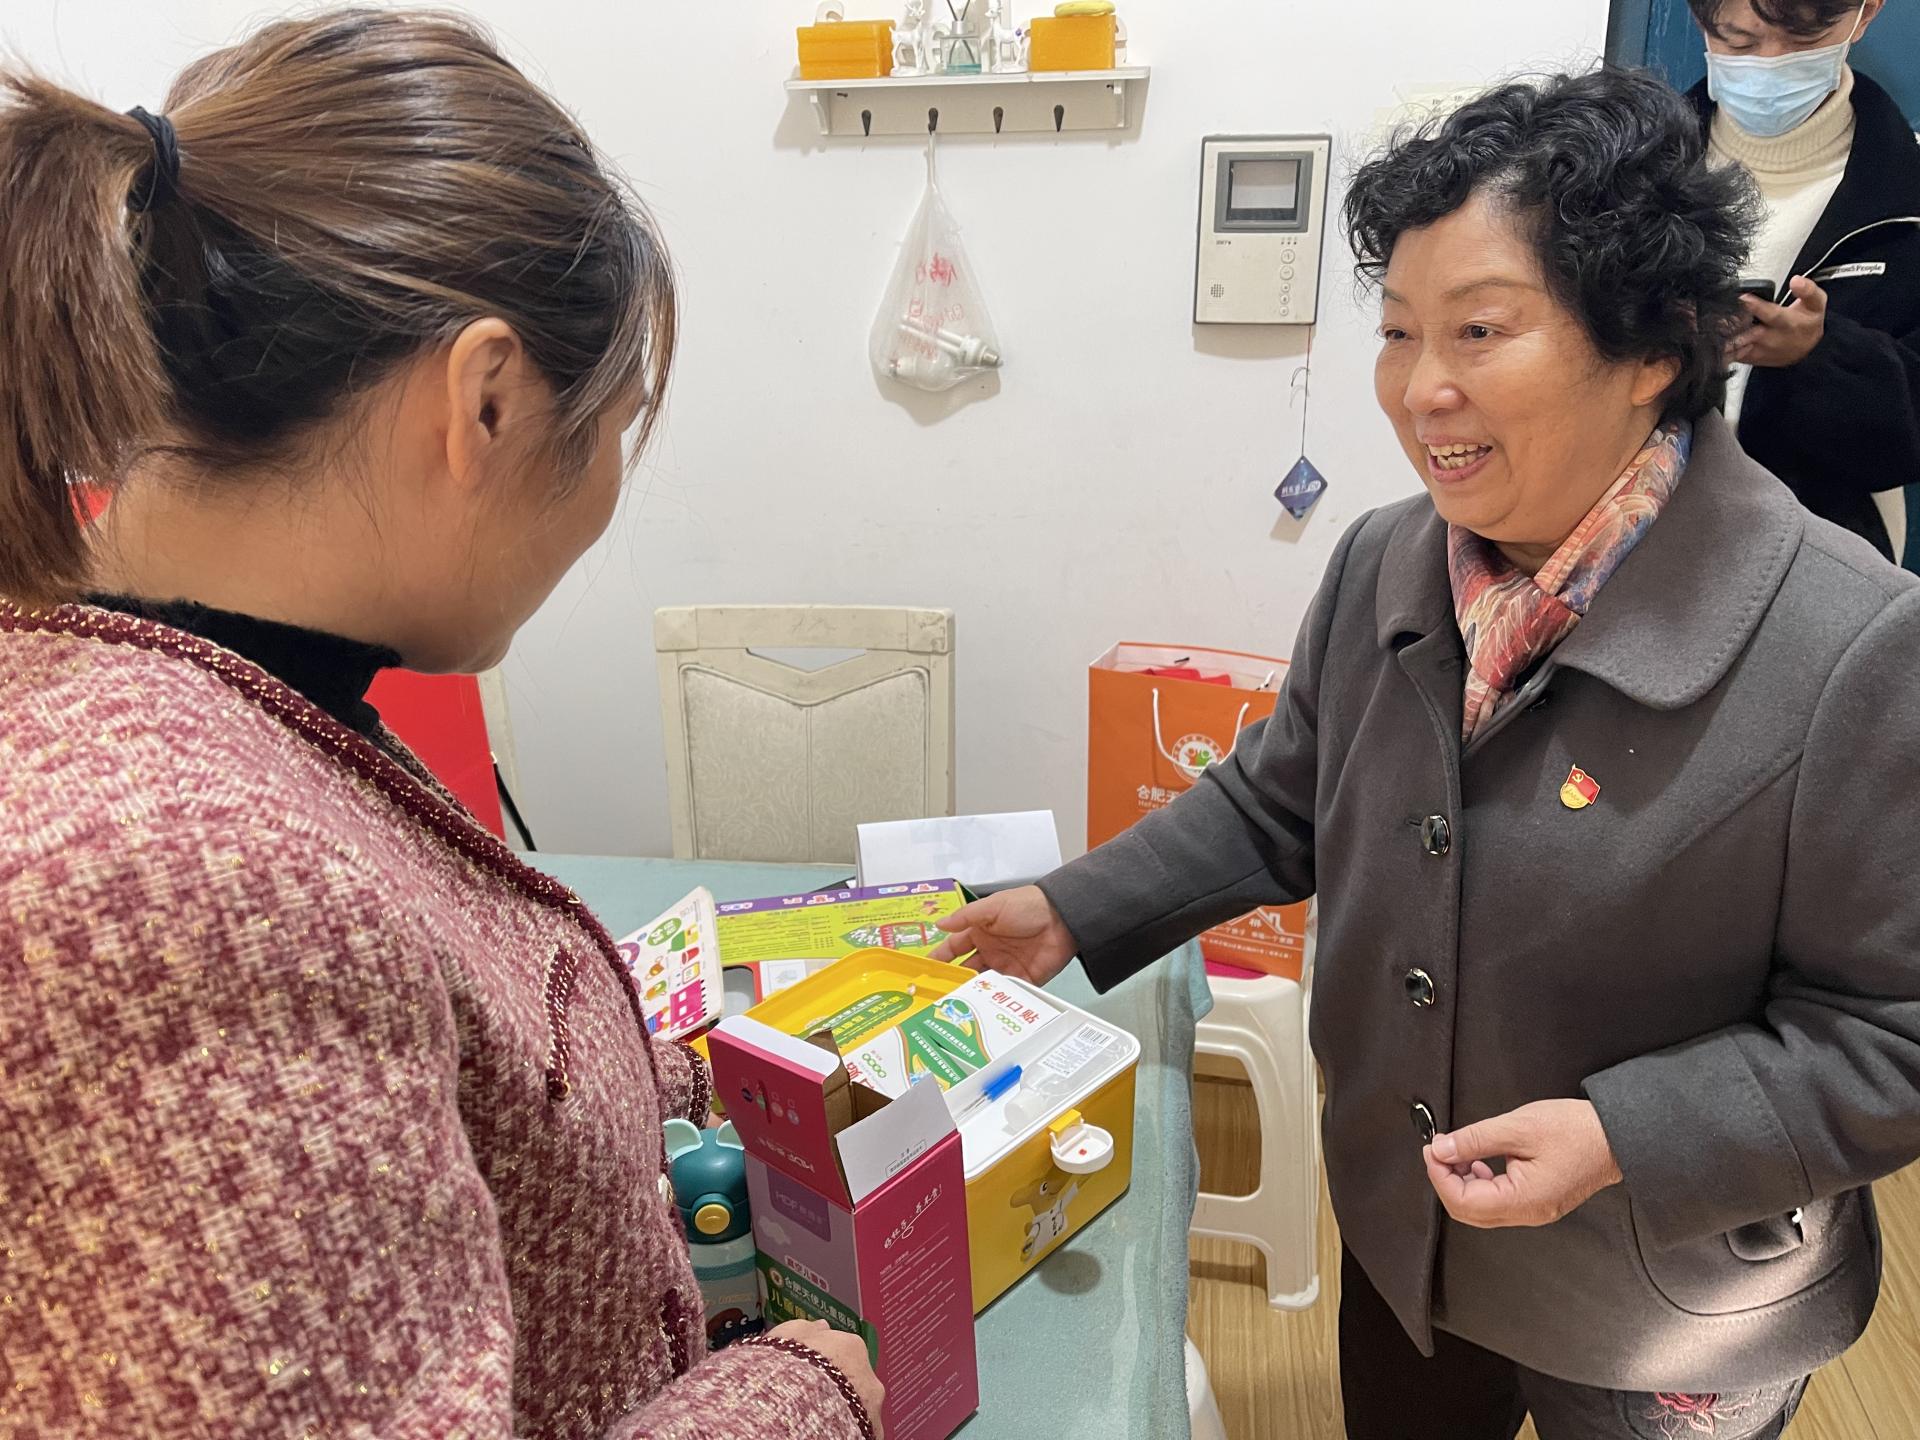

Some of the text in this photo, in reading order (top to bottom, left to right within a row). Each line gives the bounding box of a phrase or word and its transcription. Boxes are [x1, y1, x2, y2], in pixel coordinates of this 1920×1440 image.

[1856, 264, 1882, 273] People
[991, 990, 1041, 1025] 创口贴
[785, 1276, 858, 1333] 合肥天使儿童医院
